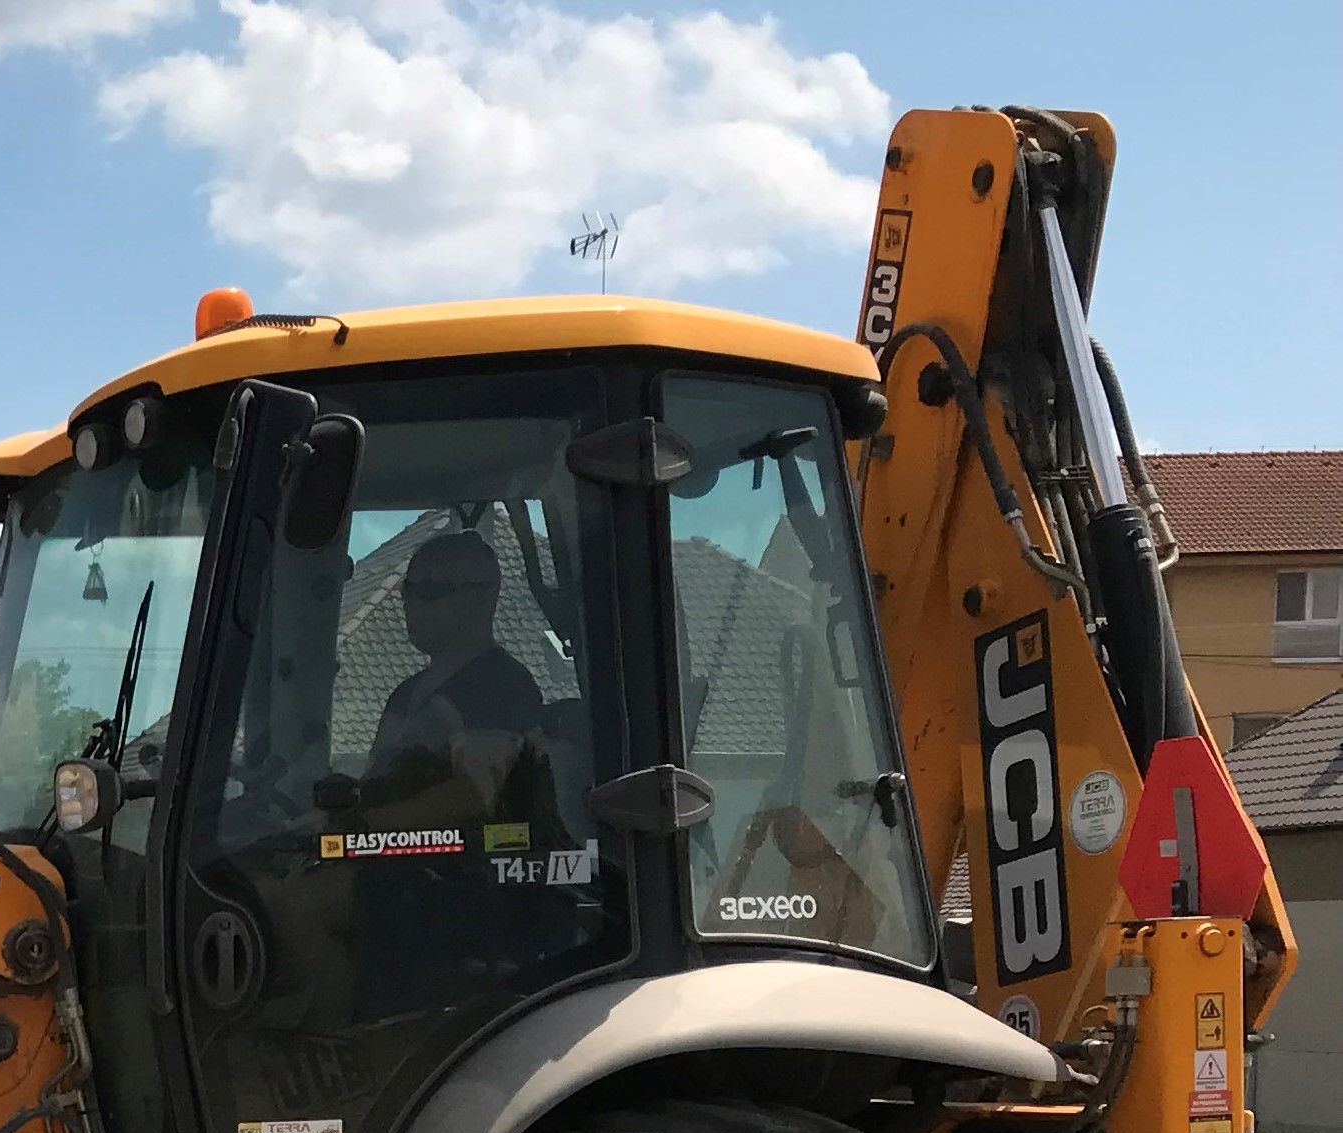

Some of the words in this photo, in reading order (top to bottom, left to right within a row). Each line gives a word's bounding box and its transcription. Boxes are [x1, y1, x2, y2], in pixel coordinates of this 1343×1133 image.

[983, 636, 1062, 973] JCB
[346, 829, 464, 855] EASYCONTROL
[719, 895, 817, 920] 3CXeco
[267, 1122, 311, 1133] TERRA
